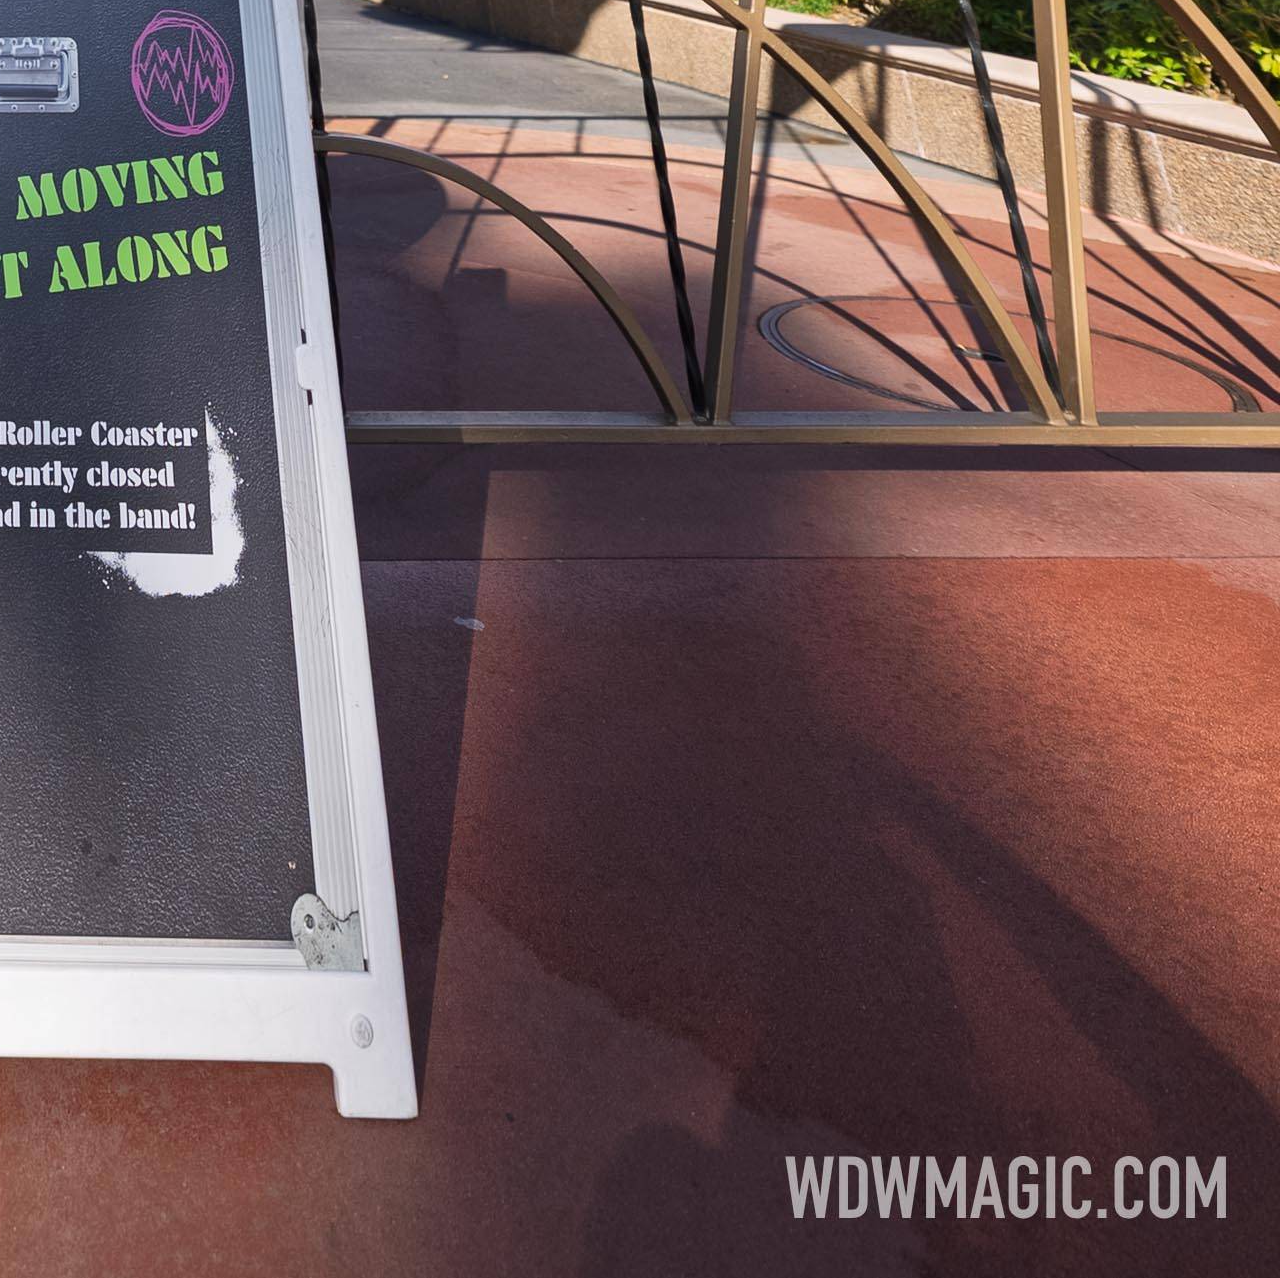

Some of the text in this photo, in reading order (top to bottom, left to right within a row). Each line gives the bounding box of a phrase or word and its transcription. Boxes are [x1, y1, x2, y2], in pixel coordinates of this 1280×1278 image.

[16, 151, 224, 220] MOVING
[48, 225, 229, 293] ALONG
[91, 421, 199, 447] Coaster
[86, 461, 174, 487] closed
[30, 503, 56, 528] in
[64, 503, 111, 529] the
[119, 502, 196, 530] band!
